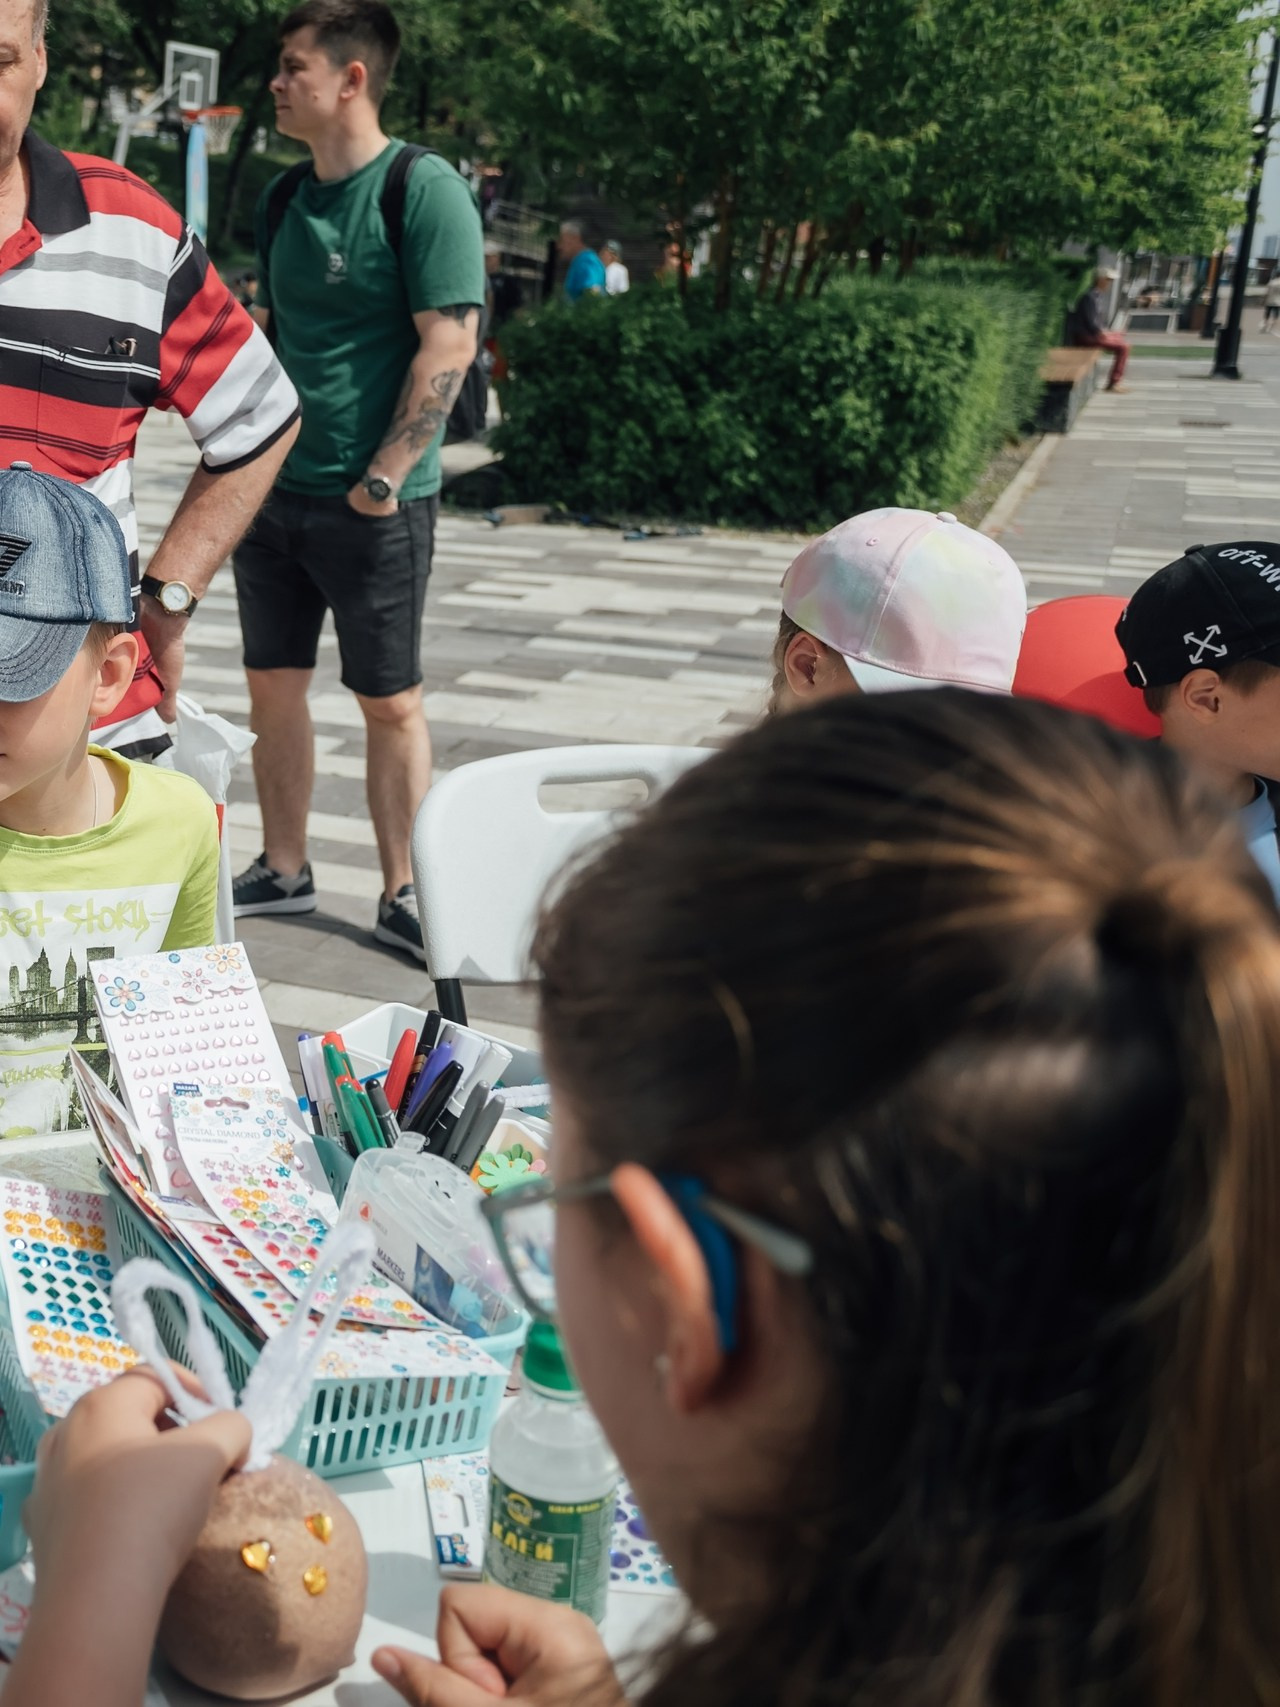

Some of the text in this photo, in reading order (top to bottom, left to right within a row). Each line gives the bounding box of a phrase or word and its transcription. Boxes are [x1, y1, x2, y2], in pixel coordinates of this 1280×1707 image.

[1218, 547, 1280, 593] off-W
[177, 1126, 261, 1140] CRYSTAL DIAMOND
